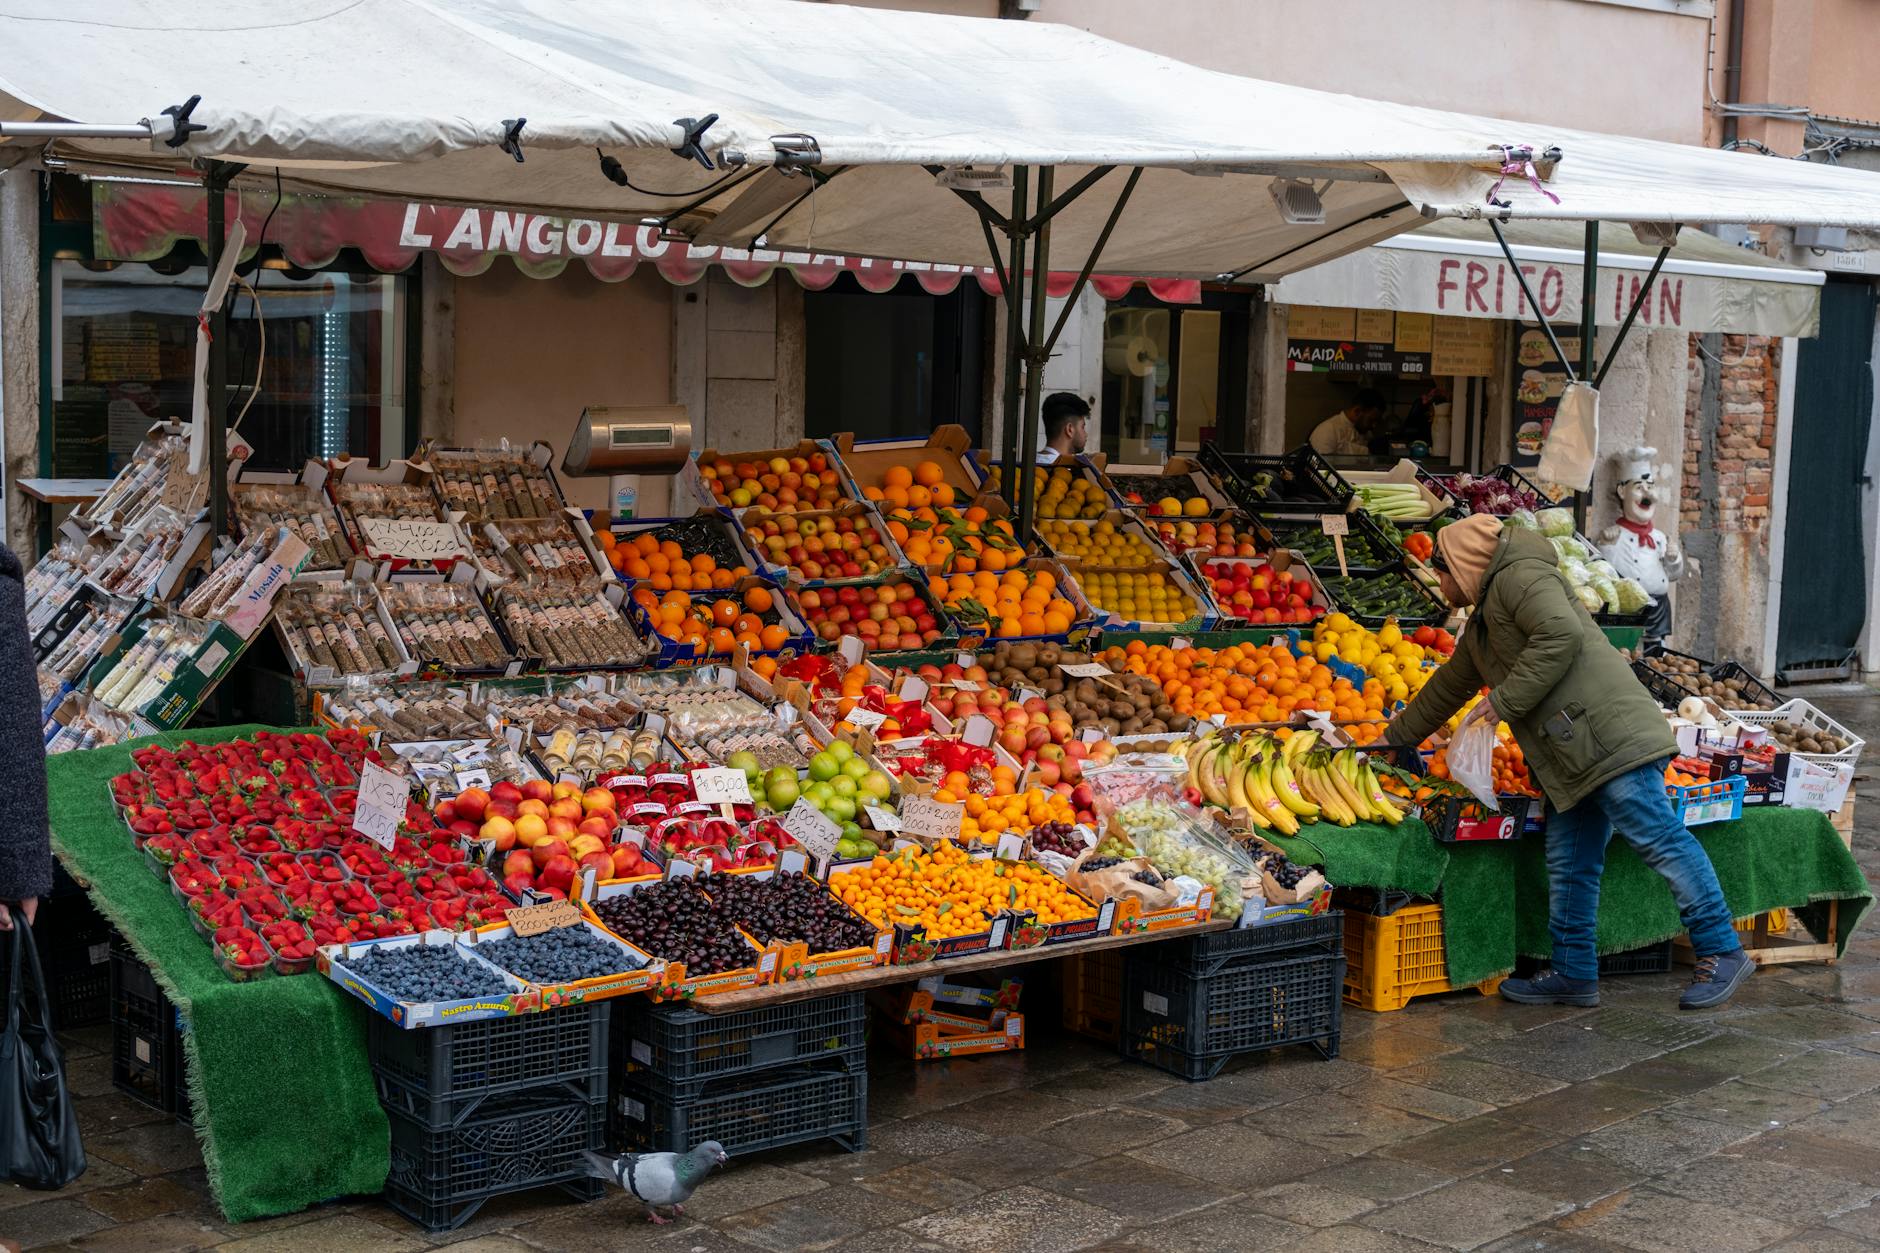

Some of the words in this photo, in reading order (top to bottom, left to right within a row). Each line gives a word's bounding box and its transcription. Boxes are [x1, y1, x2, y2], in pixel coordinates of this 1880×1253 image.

[1438, 260, 1563, 316] FRITO
[1615, 274, 1683, 326] INN
[441, 1004, 474, 1018] Nastro
[474, 1002, 510, 1011] Azzurro
